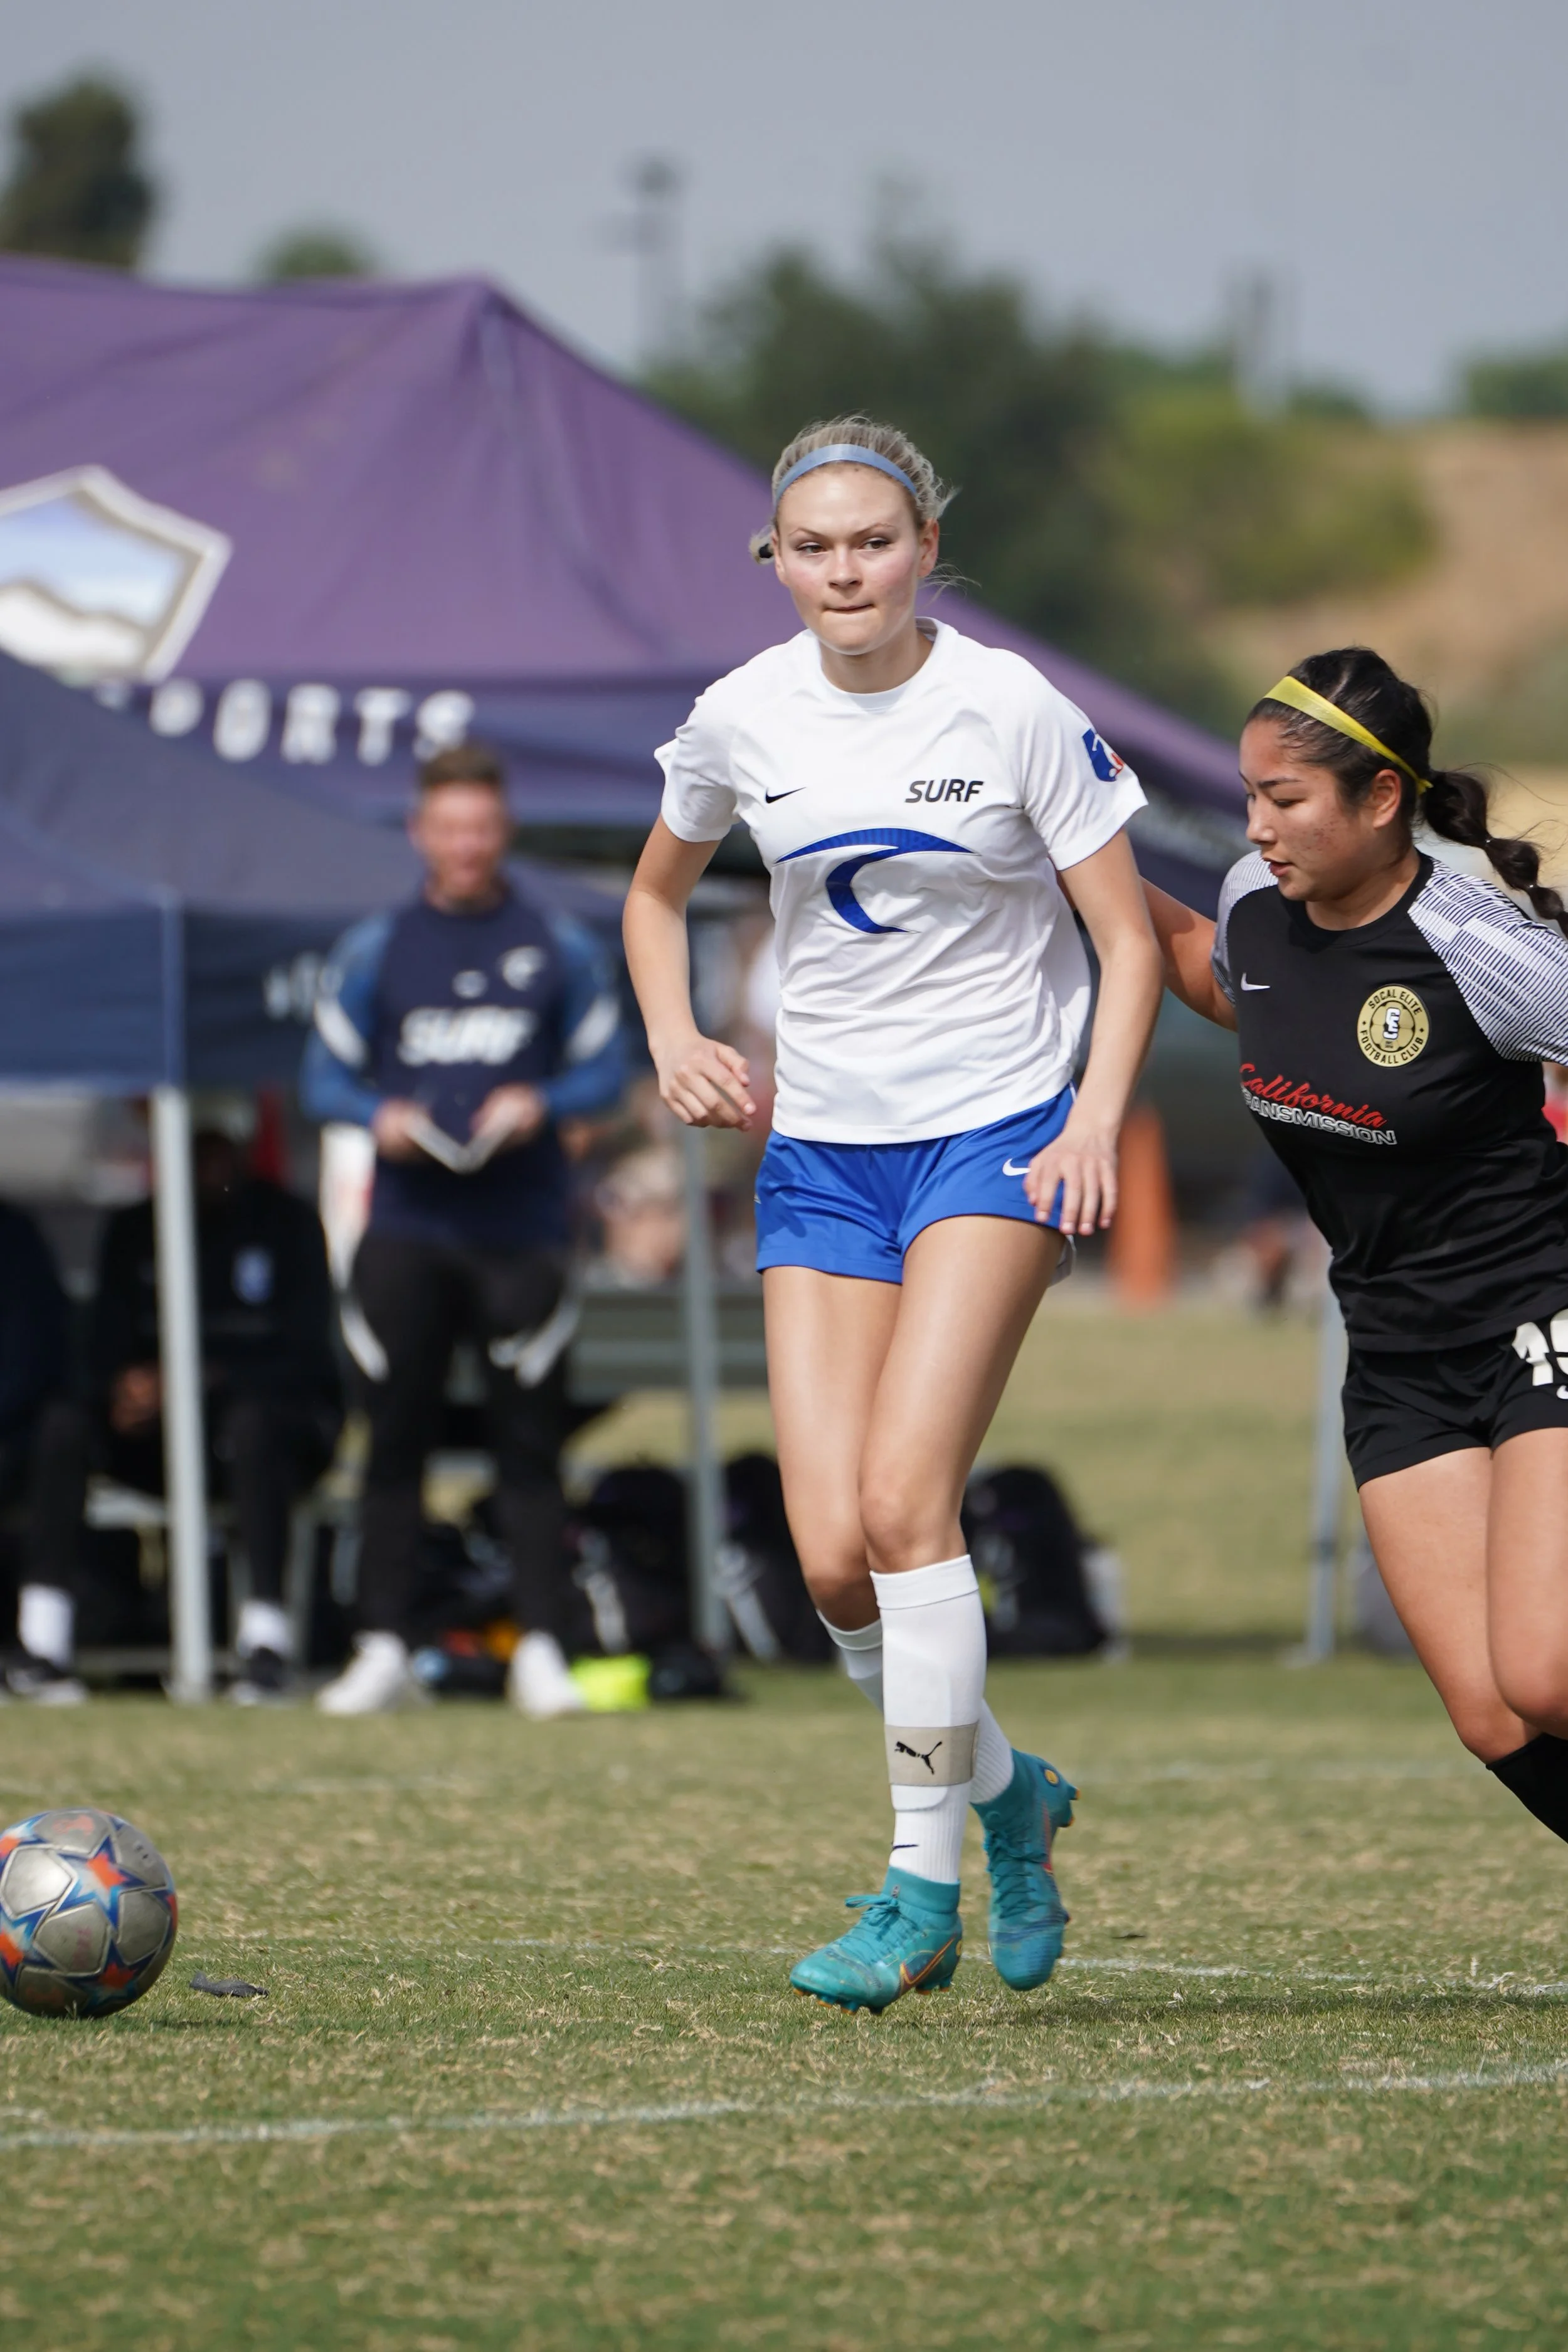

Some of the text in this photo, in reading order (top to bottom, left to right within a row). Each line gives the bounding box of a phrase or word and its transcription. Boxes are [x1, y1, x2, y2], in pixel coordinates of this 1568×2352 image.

[94, 677, 475, 765] PORTS
[904, 779, 984, 803] SURF
[1368, 989, 1422, 1015] SOCAL ELITE
[1360, 1029, 1424, 1064] FOOTBALL CLUB
[1239, 1062, 1387, 1128] California
[1241, 1083, 1397, 1146] RANSMISSION
